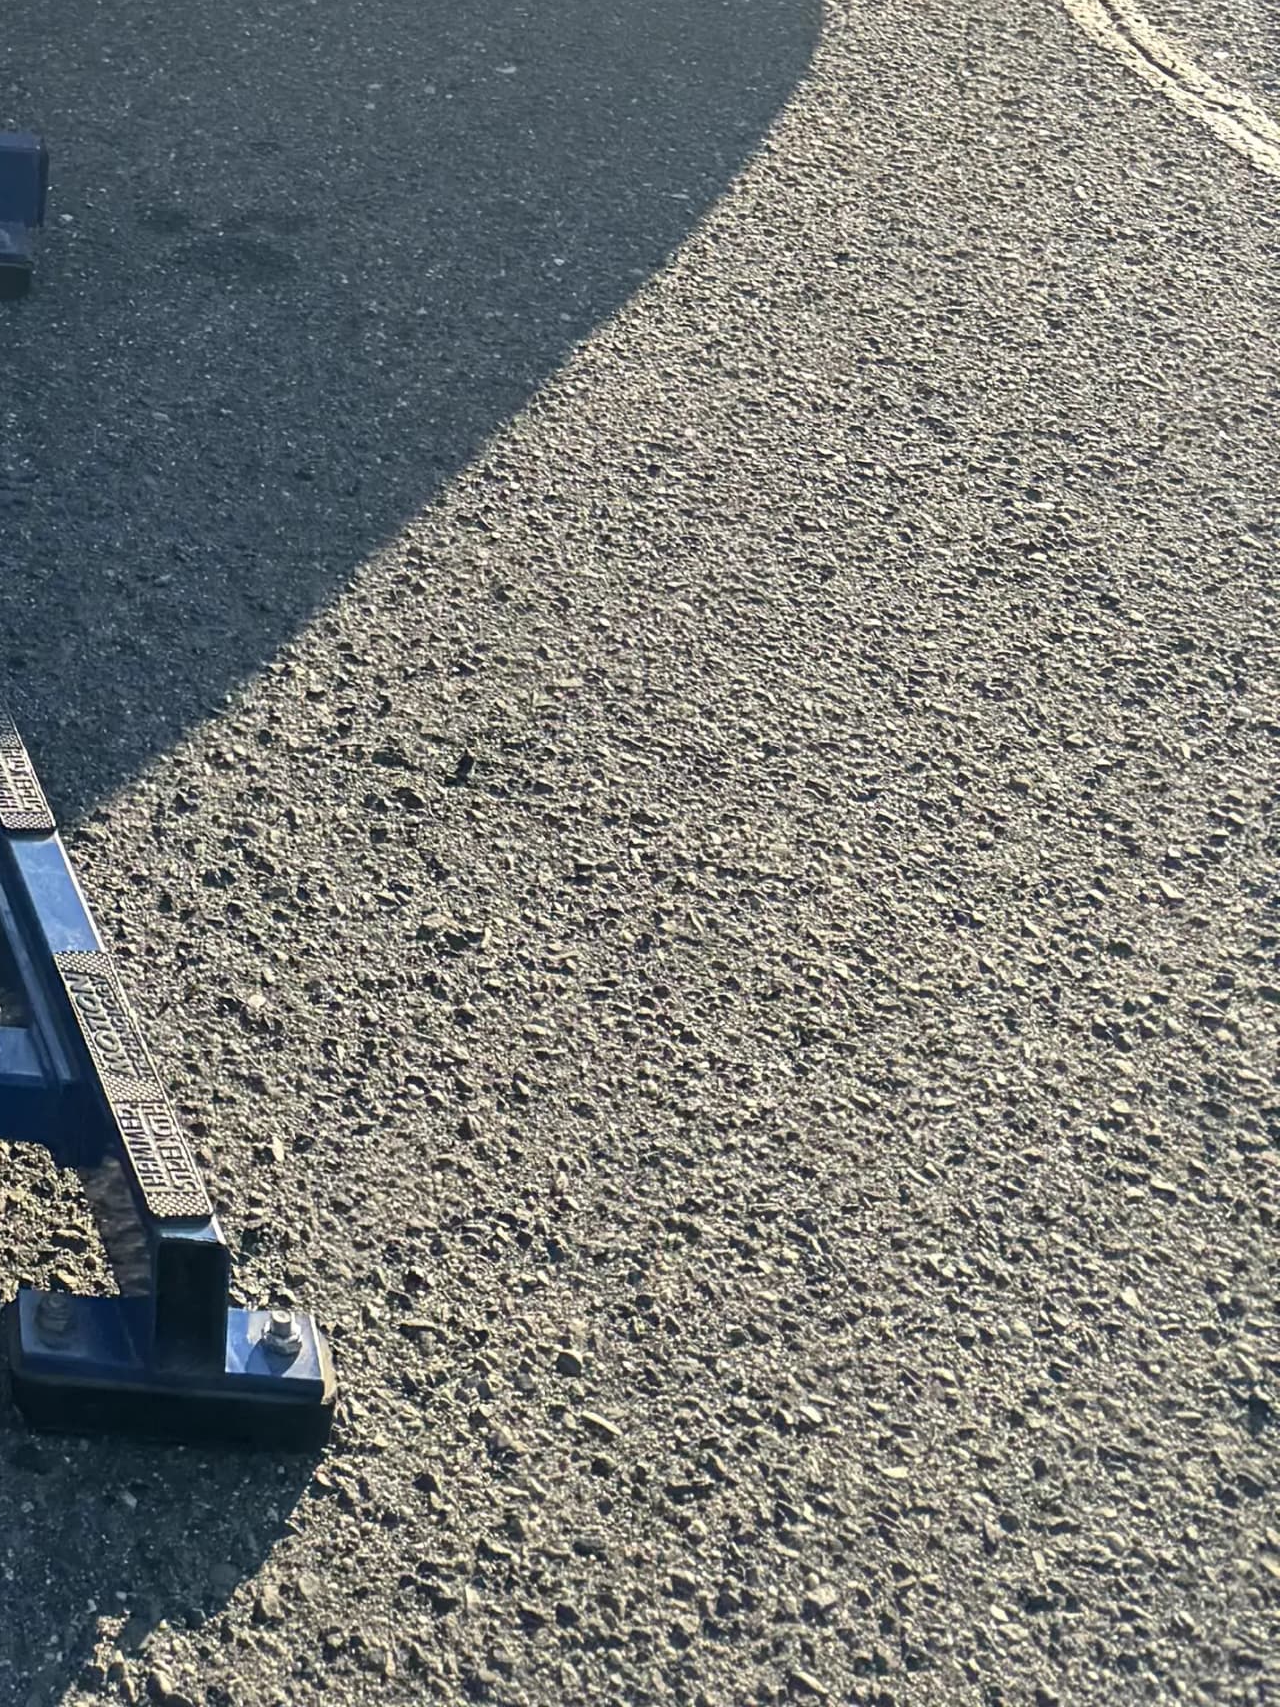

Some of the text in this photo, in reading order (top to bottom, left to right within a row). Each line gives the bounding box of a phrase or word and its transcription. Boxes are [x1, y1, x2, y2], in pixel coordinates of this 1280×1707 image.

[62, 971, 136, 1076] MOTION
[115, 1107, 167, 1188] HAMMER
[140, 1102, 199, 1192] STRENGTH
